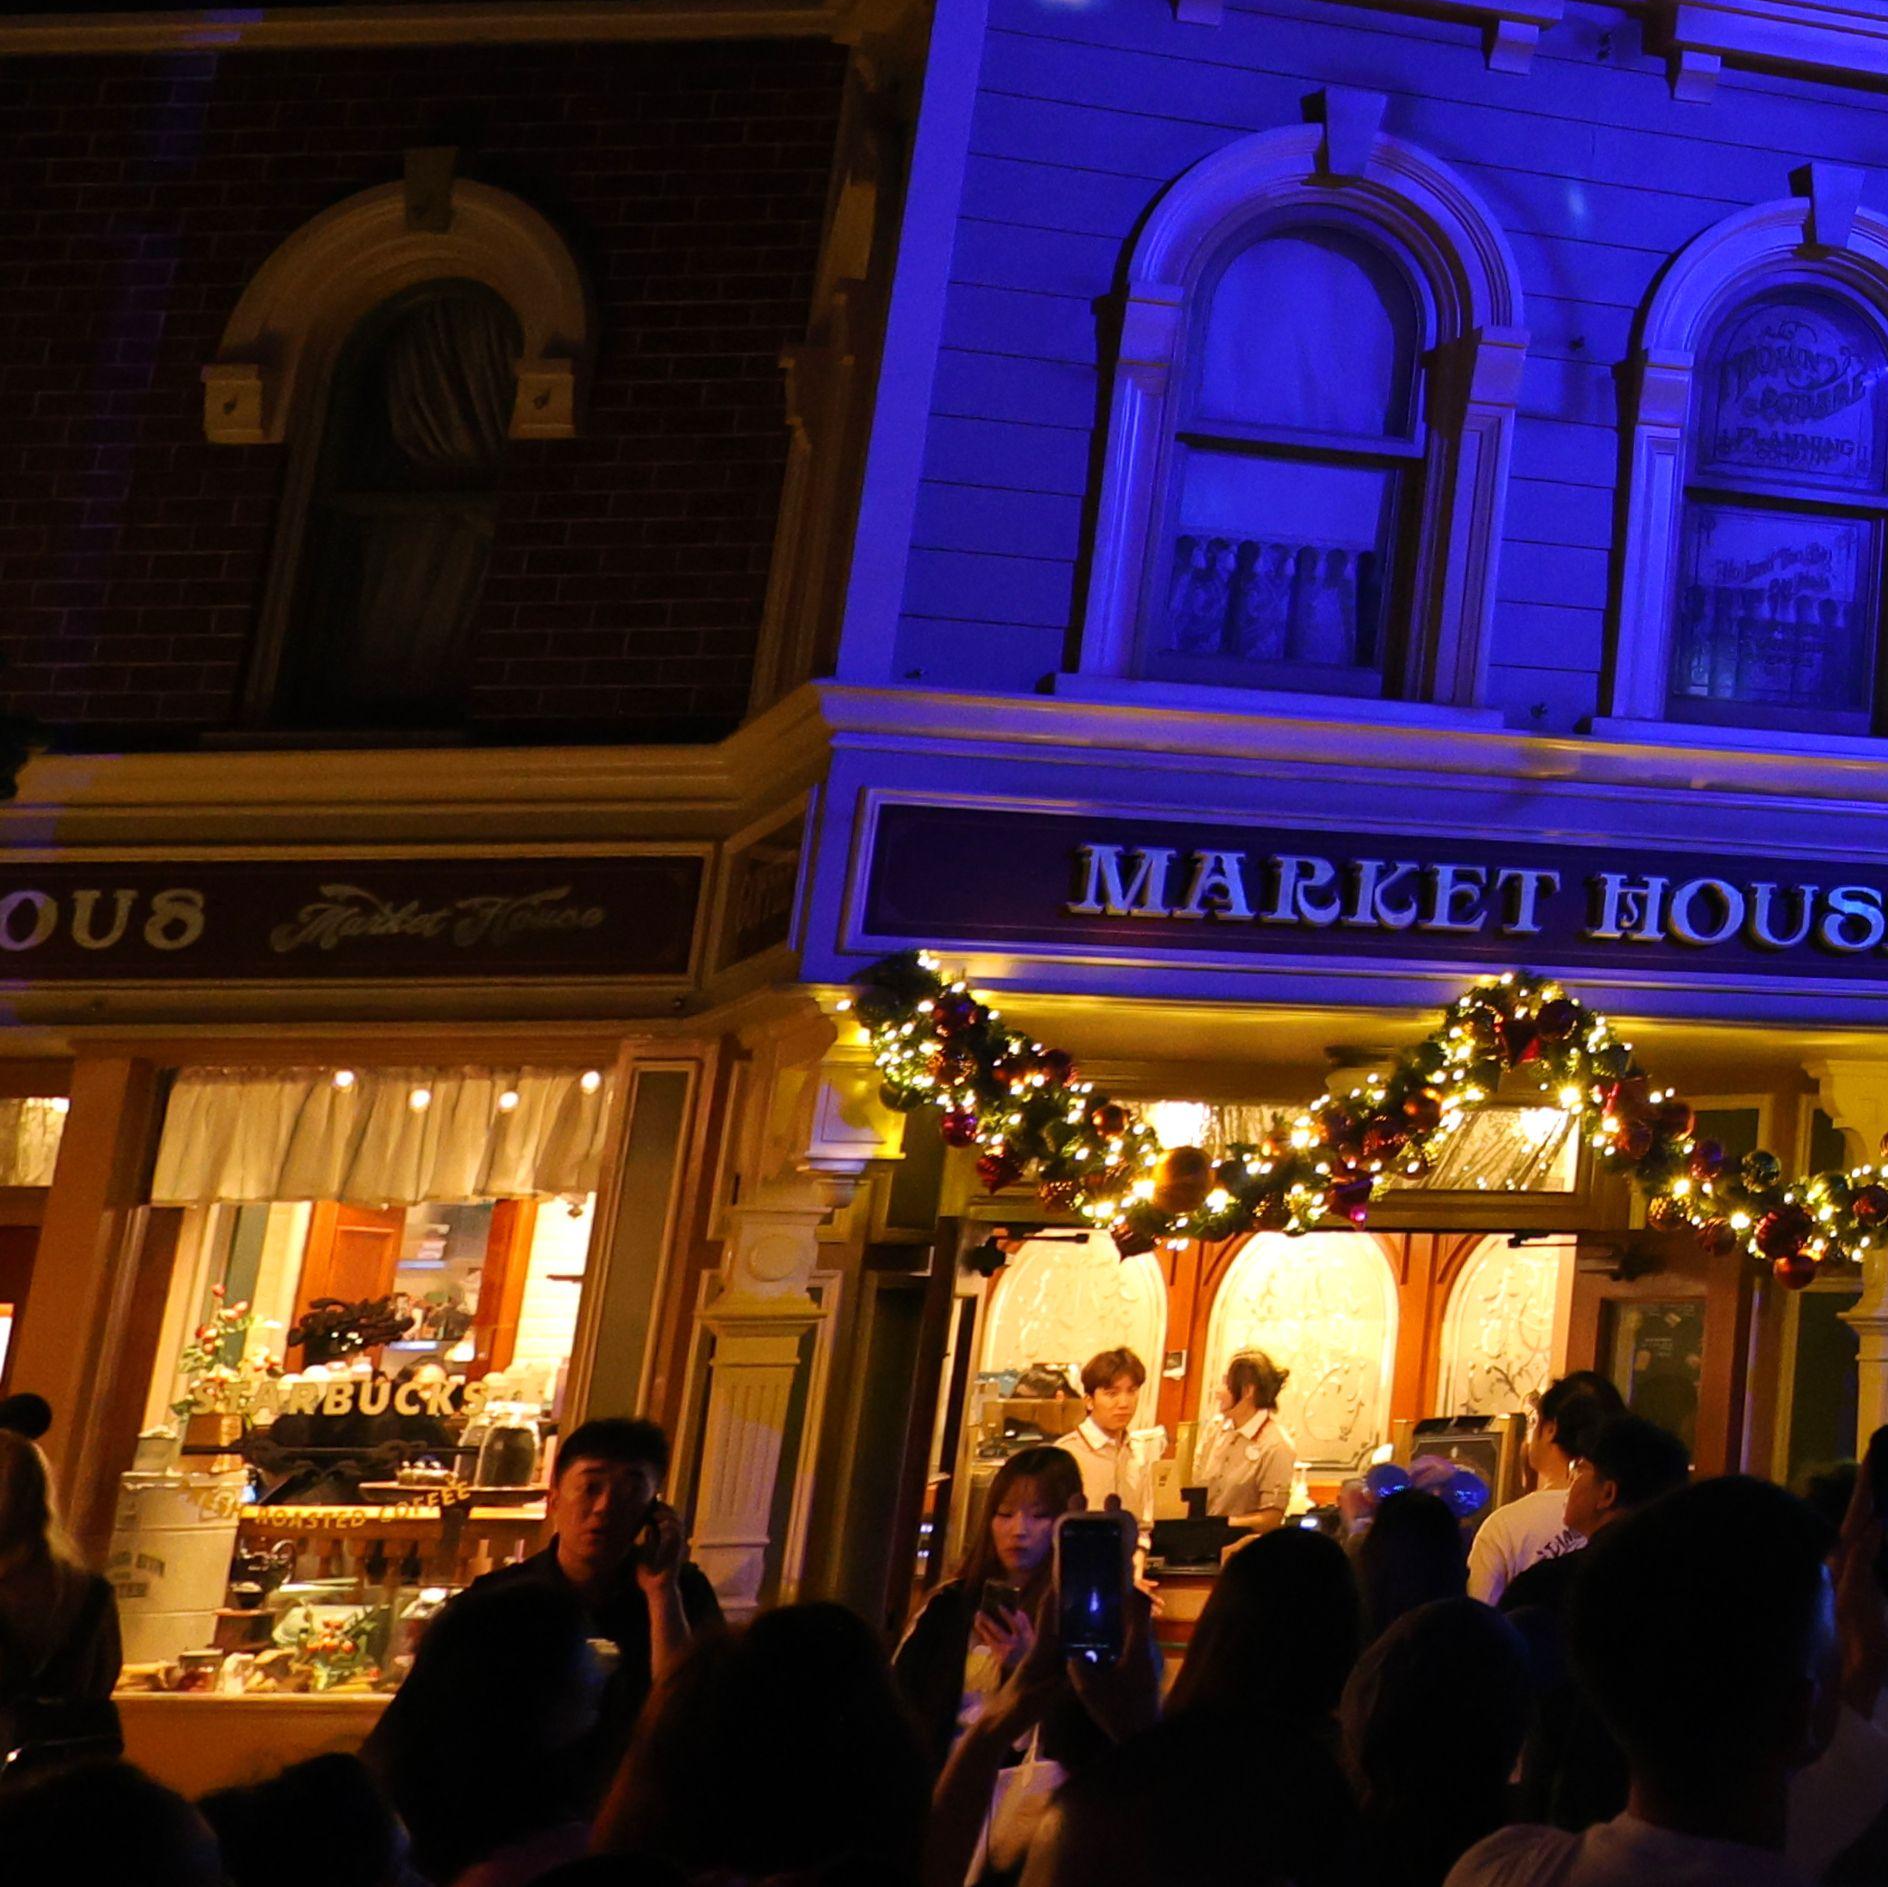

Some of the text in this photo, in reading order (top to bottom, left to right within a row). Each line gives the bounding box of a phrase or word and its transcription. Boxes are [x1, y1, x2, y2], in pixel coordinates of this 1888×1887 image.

[1736, 427, 1856, 456] PLANNING
[1068, 842, 1562, 937] MARKET
[190, 1377, 488, 1419] STARBUCKS
[379, 1476, 472, 1524] COFFEE
